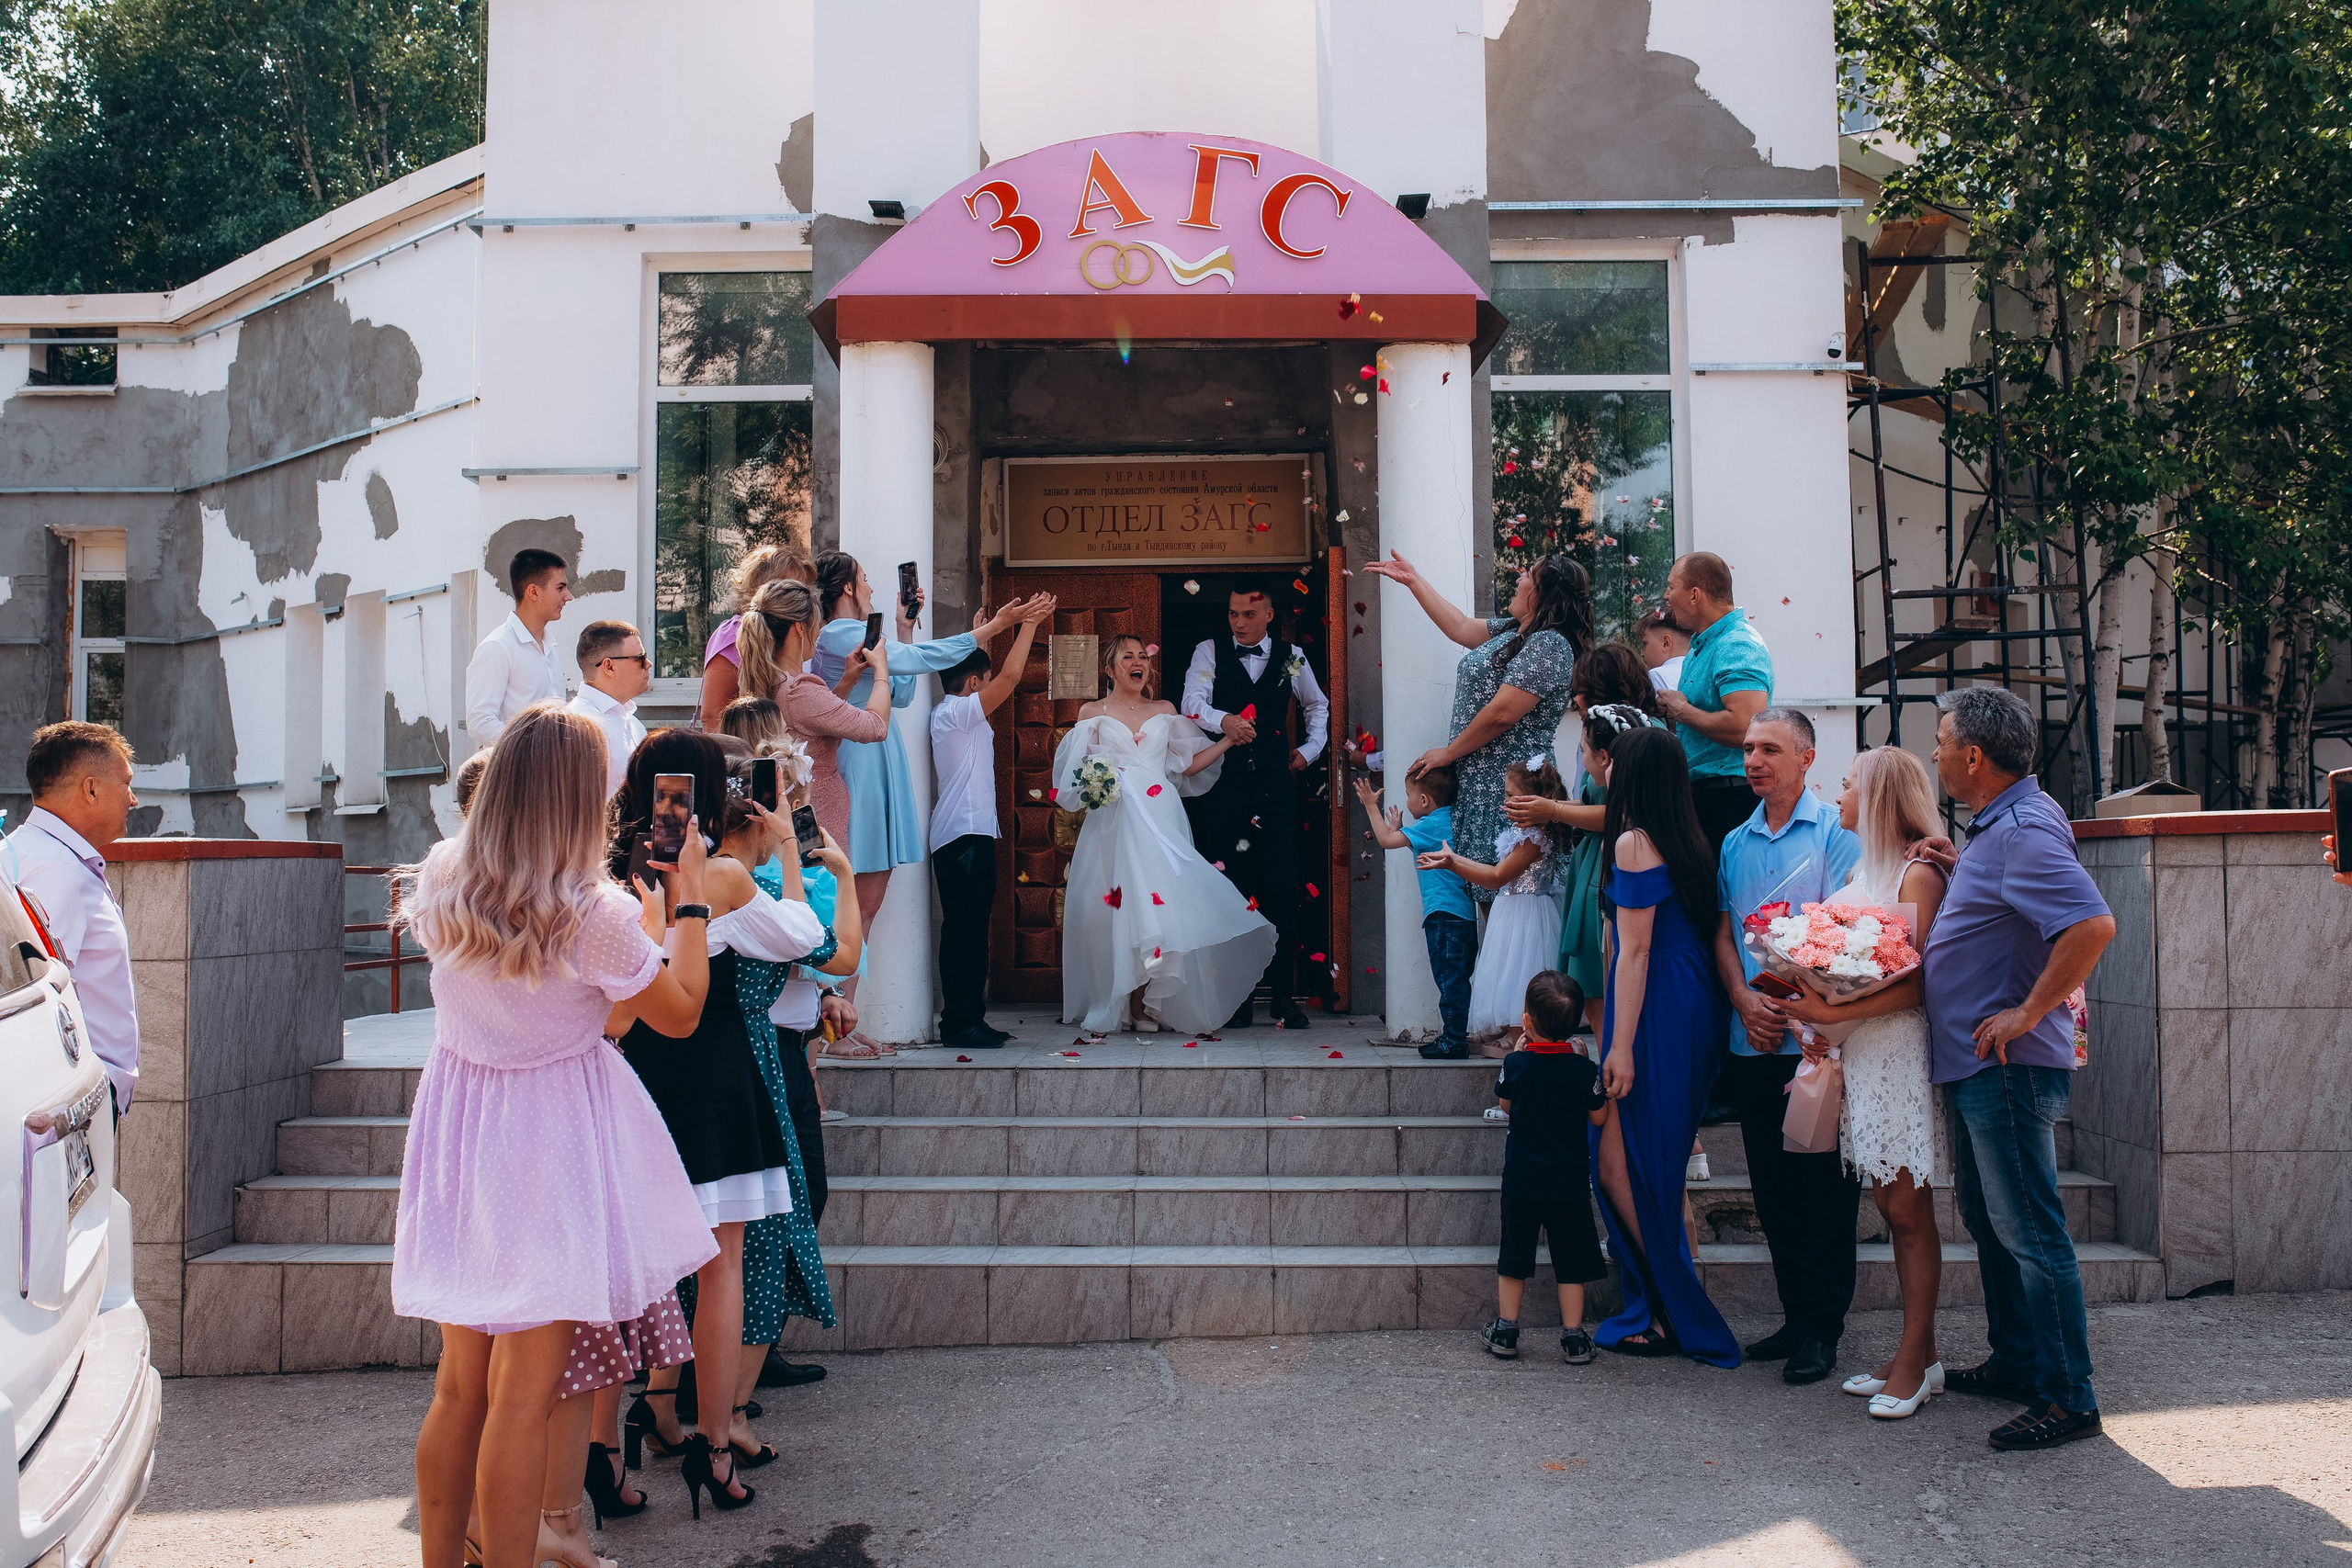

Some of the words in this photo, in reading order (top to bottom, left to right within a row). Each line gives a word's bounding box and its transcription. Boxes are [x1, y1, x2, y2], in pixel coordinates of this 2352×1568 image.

[961, 143, 1353, 266] ЗАГС
[1105, 469, 1208, 483] УПРАВЛЕНИЕ
[1043, 488, 1069, 496] записи
[1074, 487, 1096, 496] актов
[1101, 487, 1155, 497] гражданского
[1159, 485, 1199, 494] состояния
[1204, 482, 1243, 496] Амурской
[1247, 483, 1278, 493] области
[1042, 504, 1166, 539] ОТДЕЛ
[1180, 502, 1272, 533] ЗАГС
[1087, 542, 1097, 551] по
[1101, 540, 1131, 552] г.Тында
[1135, 542, 1140, 550] и
[1145, 539, 1196, 552] Тындинскому
[1200, 539, 1227, 552] району
